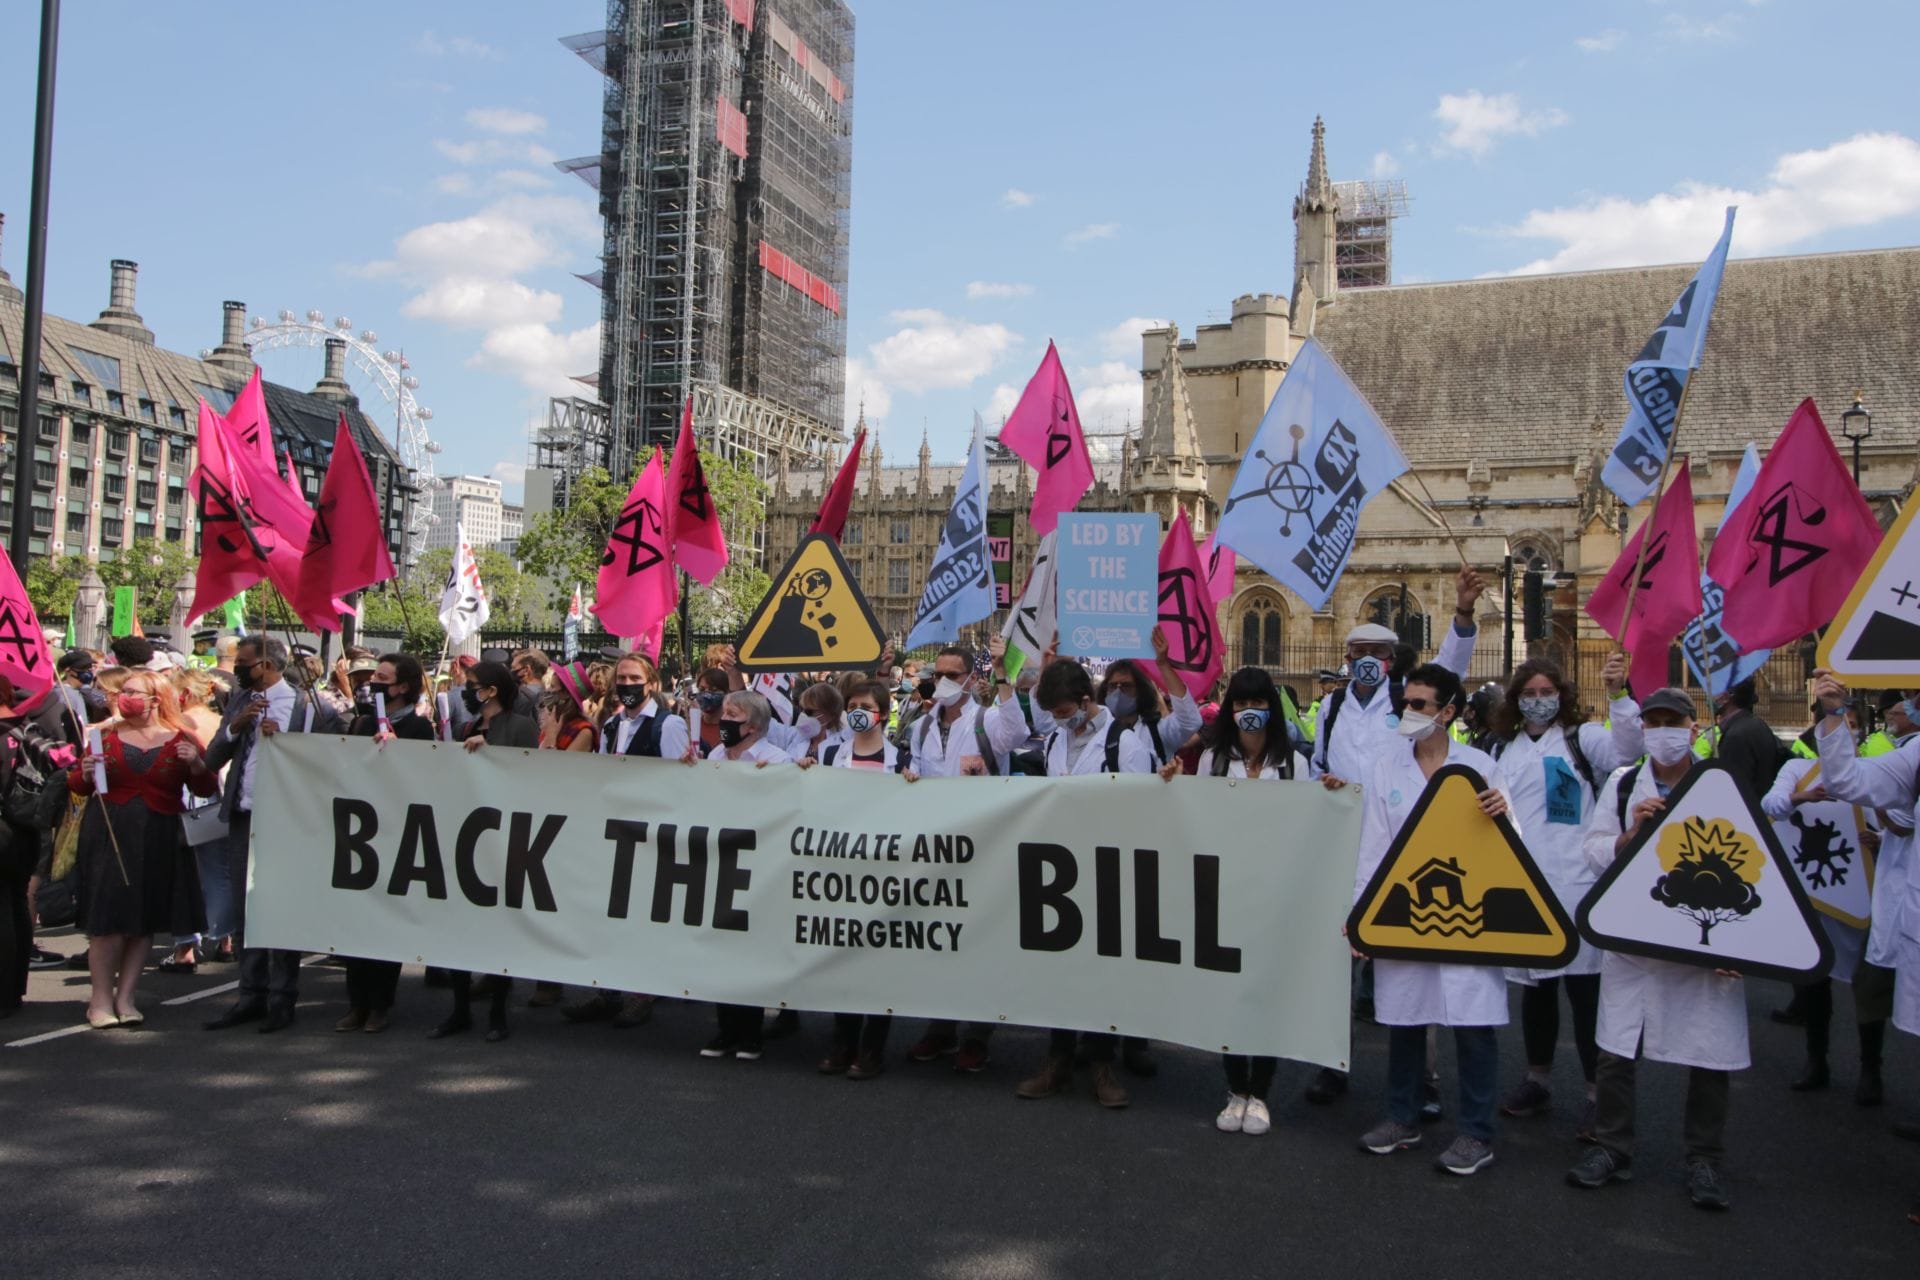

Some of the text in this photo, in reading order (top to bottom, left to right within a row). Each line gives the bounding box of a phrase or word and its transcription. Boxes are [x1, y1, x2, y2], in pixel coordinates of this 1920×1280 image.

[1072, 523, 1144, 545] LED BY
[1088, 556, 1126, 578] THE
[1065, 588, 1149, 612] SCIENCE
[790, 826, 974, 863] CLIMATE AND
[332, 797, 756, 931] BACK THE
[793, 871, 969, 907] ECOLOGICAL
[1018, 842, 1241, 973] BILL
[796, 915, 963, 951] EMERGENCY
